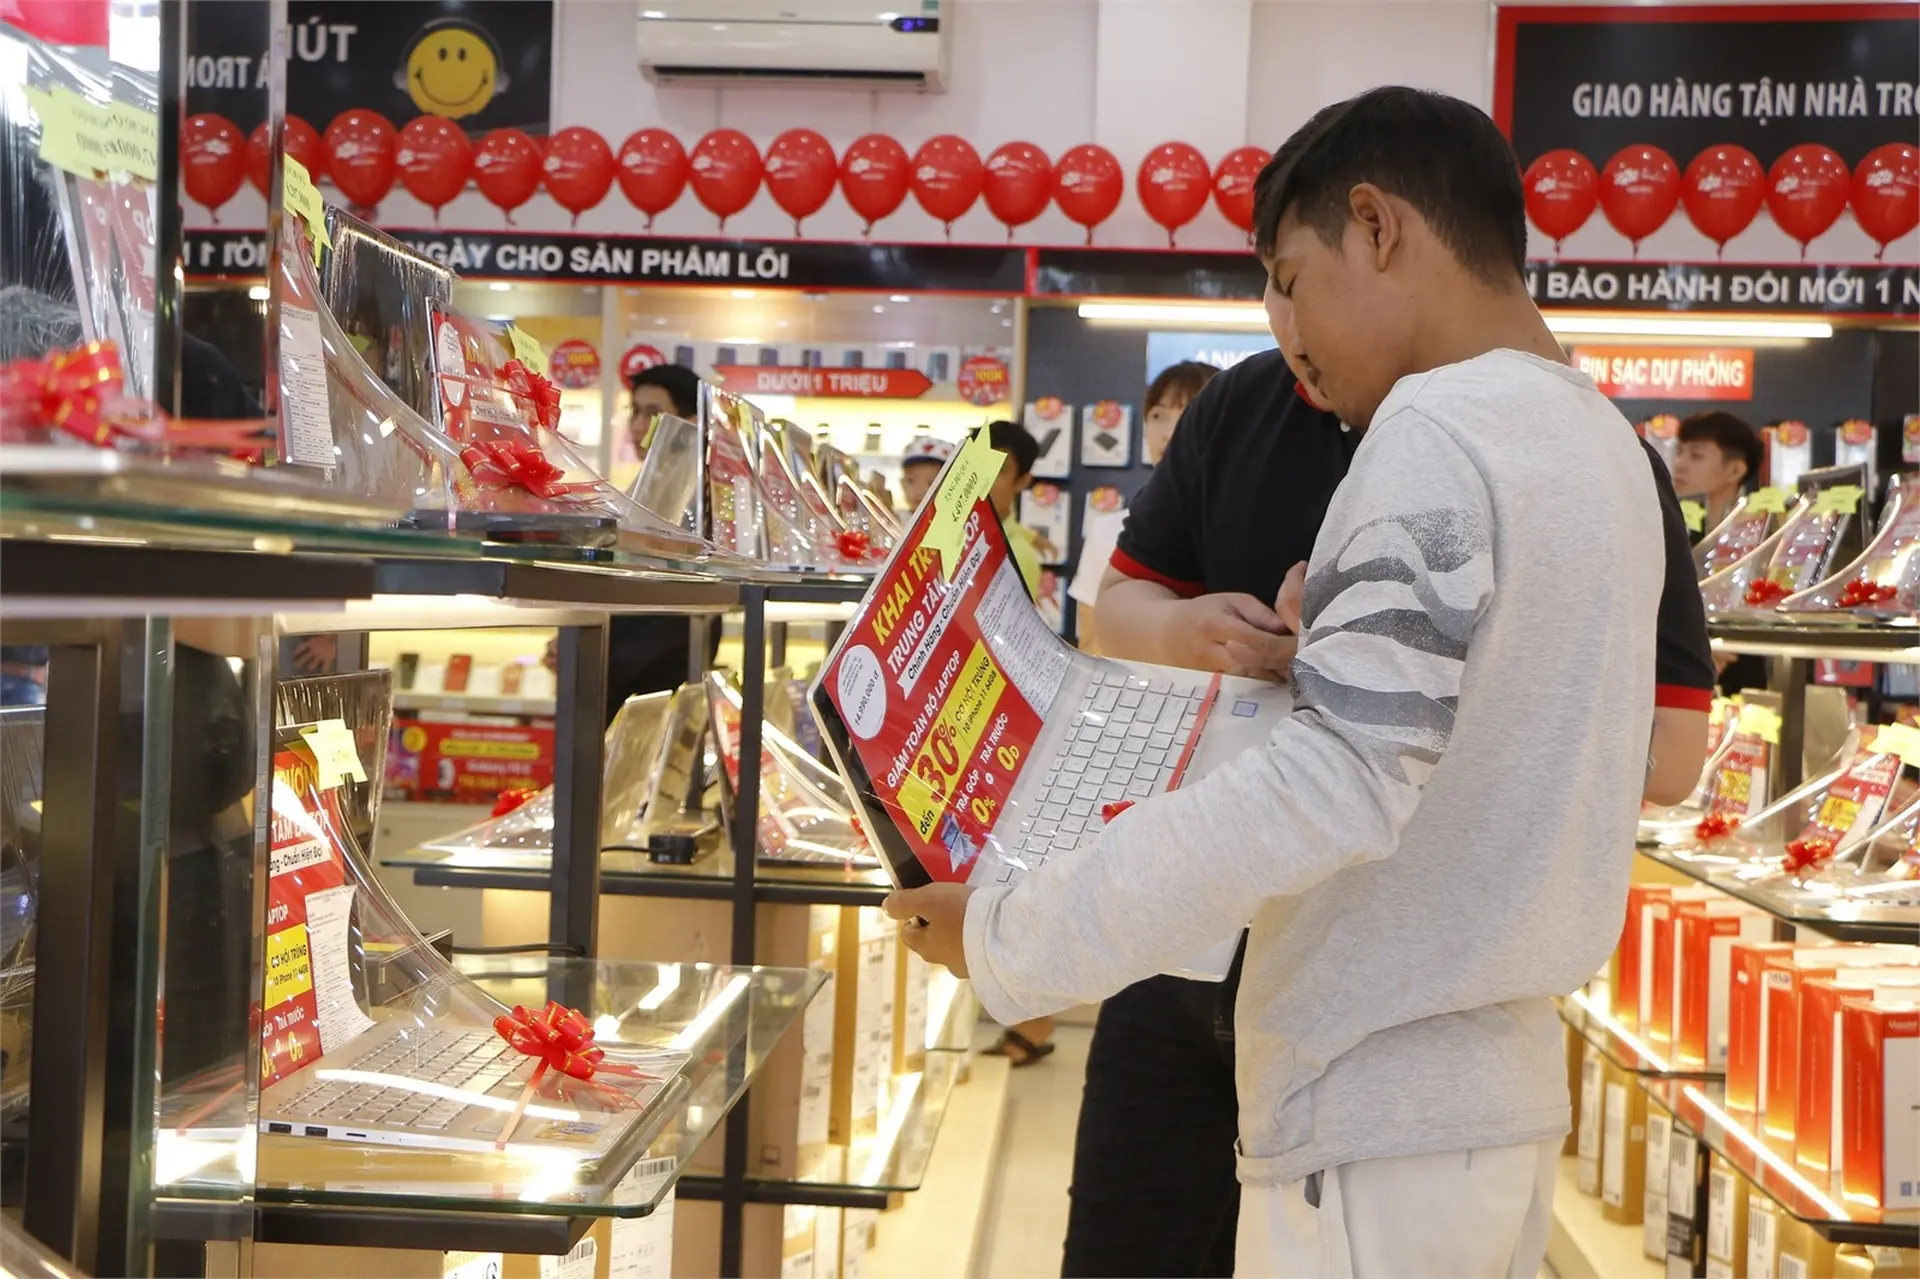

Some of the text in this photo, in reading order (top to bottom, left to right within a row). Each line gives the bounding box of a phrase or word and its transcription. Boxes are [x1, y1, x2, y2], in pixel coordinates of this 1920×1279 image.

[1572, 83, 1642, 117] GIAO
[1650, 76, 1732, 117] HÀNG
[1739, 76, 1797, 126] TẬN
[1804, 76, 1868, 117] NHÀ
[496, 244, 564, 272] CHO
[570, 242, 633, 275] SẢN
[641, 244, 730, 277] PHẨM
[1547, 266, 1620, 299] BẢO
[1627, 265, 1721, 301] HÀNH
[1800, 270, 1864, 304] MỚI
[1875, 278, 1891, 303] 1
[827, 372, 889, 395] TRIỆU
[1611, 356, 1649, 391] SẠC
[1652, 357, 1679, 392] DỰ
[1682, 351, 1745, 387] PHÒNG
[872, 569, 914, 646] KHAI
[887, 610, 925, 675] TRUNG
[908, 648, 927, 680] Chính
[923, 625, 942, 652] Hãng
[887, 650, 960, 788] GIẢM TOÀN BỘ LAPTOP
[917, 718, 960, 835] đến 30%
[979, 741, 994, 765] TRẢ
[955, 768, 981, 814] TRẢ GÓP
